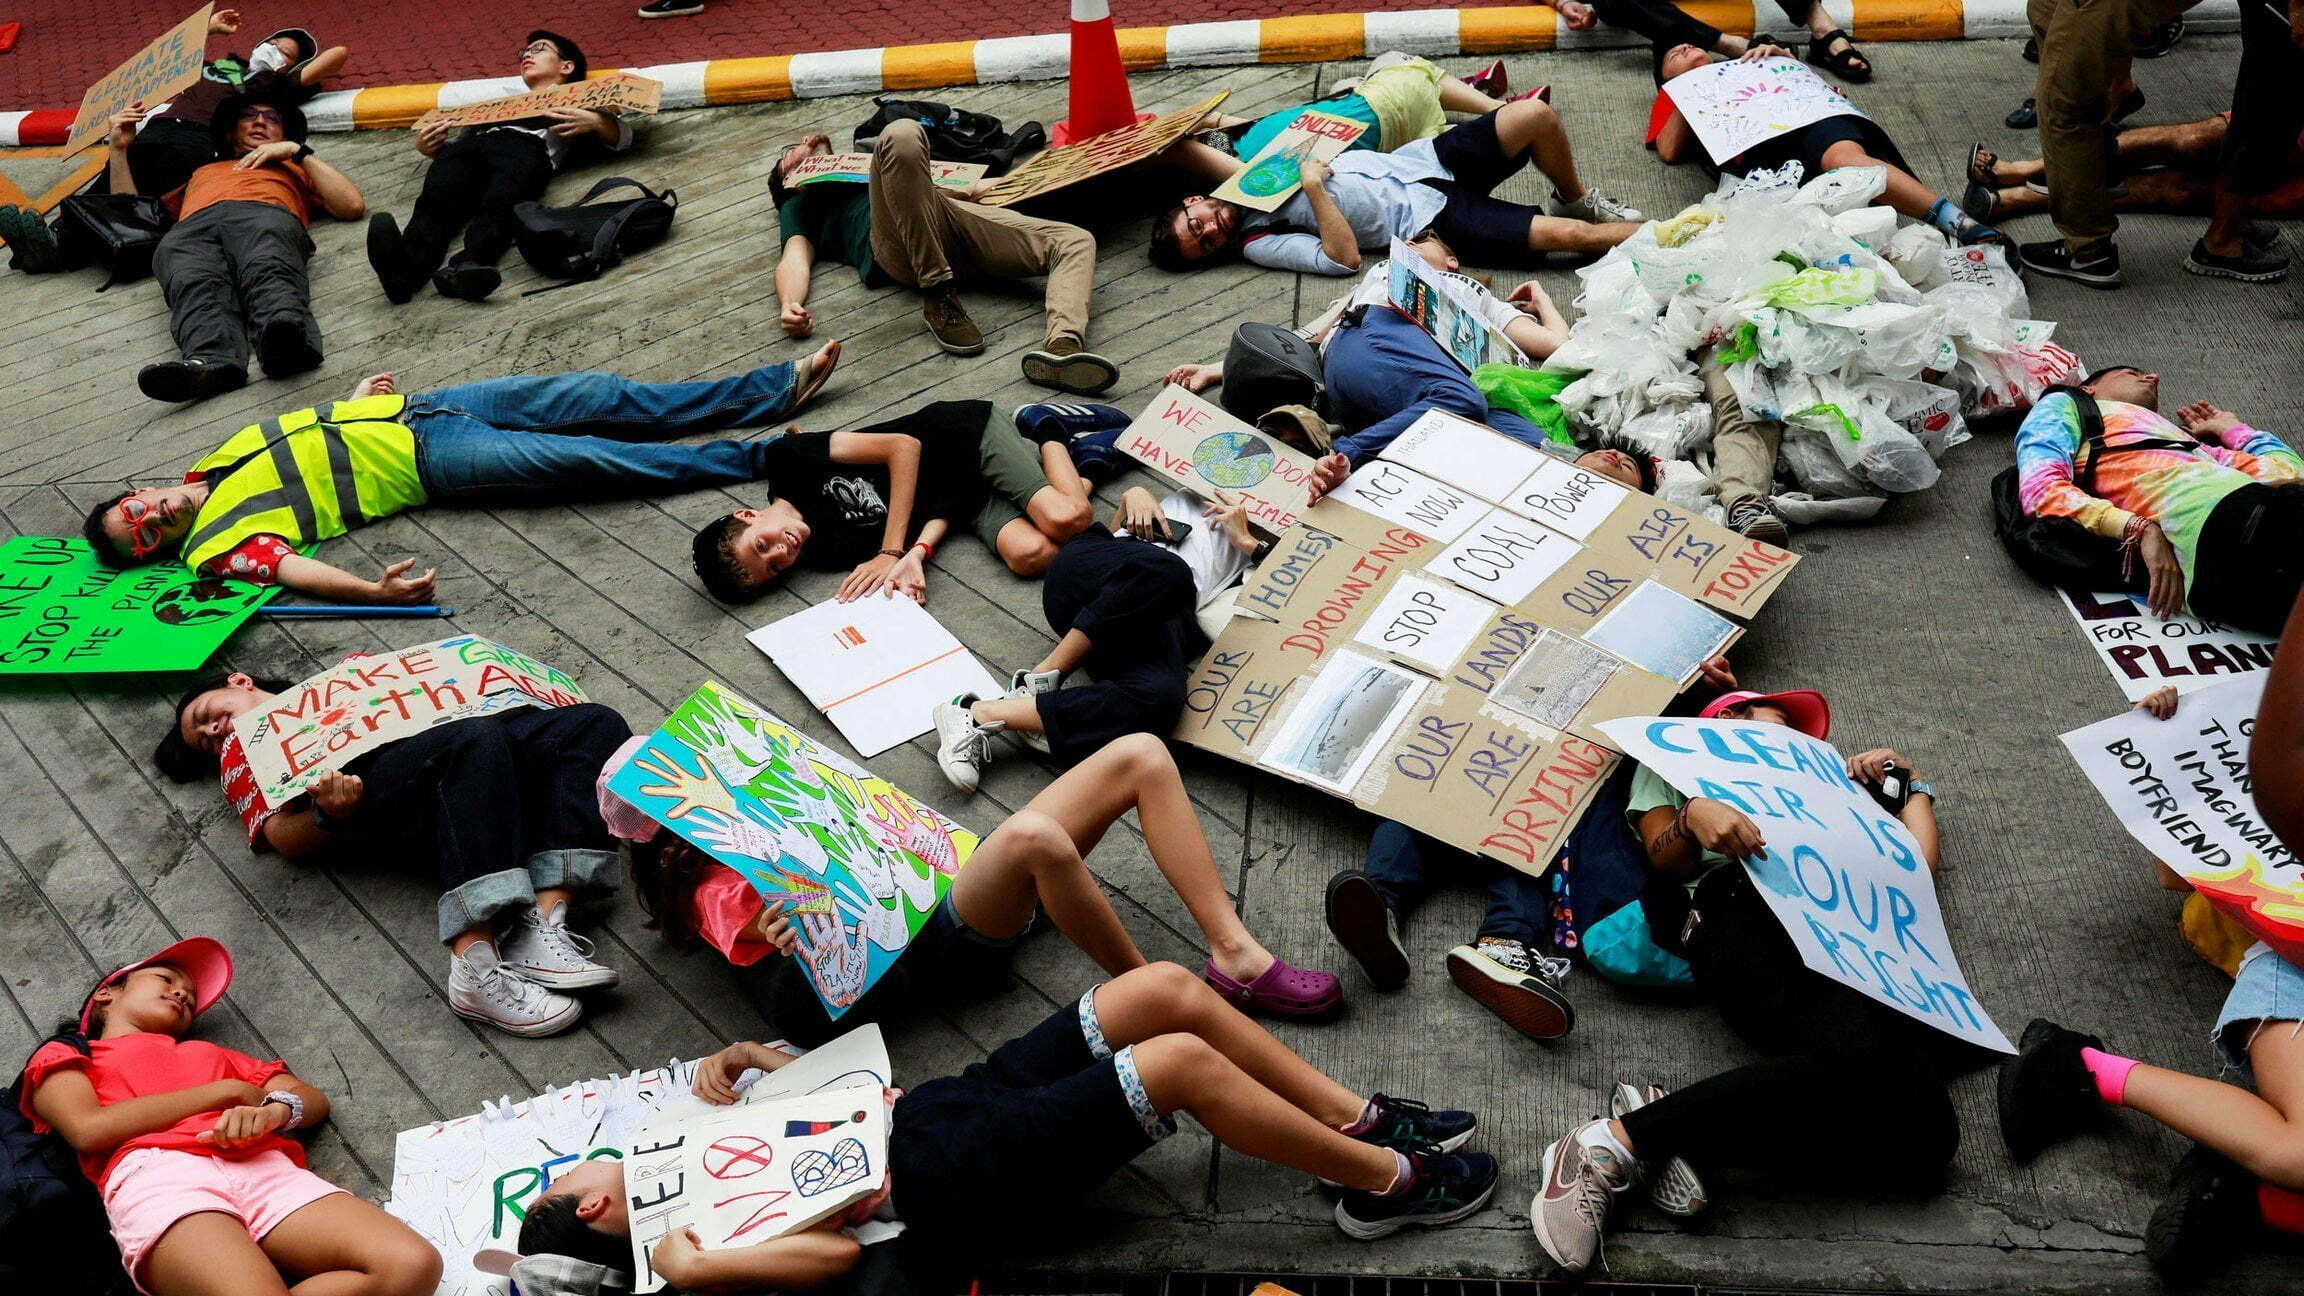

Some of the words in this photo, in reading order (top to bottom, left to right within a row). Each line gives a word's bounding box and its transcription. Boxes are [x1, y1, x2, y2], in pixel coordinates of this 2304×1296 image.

[90, 28, 186, 105] CLIMATE
[569, 76, 638, 94] LAST
[1161, 399, 1213, 433] WE
[1130, 436, 1194, 476] HAVE
[1355, 466, 1410, 508] ACT
[1238, 491, 1297, 528] TIME
[1405, 487, 1465, 527] NOW
[1524, 472, 1607, 521] POWER
[13, 538, 90, 566] UP
[1453, 525, 1548, 582] COAL
[1562, 569, 1633, 616] OUR
[1626, 508, 1688, 560] AIR
[1672, 534, 1715, 568] IS
[1703, 541, 1792, 600] TOXIC
[0, 605, 80, 663] STOP
[62, 627, 125, 662] THE
[111, 561, 186, 610] PLANE
[1185, 650, 1248, 713] OUR
[1249, 531, 1334, 610] HOMES
[1221, 680, 1281, 740] ARE
[1280, 528, 1430, 660] DROWNING
[1384, 591, 1446, 647] STOP
[2161, 621, 2233, 638] OUR
[267, 649, 443, 735] MAKE
[459, 640, 581, 696] GREA
[477, 664, 585, 707] AGAI
[1394, 715, 1467, 781] OUR
[1454, 613, 1540, 694] LANDS
[279, 681, 466, 779] Earth
[1463, 730, 1531, 798] ARE
[1645, 721, 1858, 795] CLEAN
[2199, 717, 2253, 795] THAN
[1479, 738, 1614, 863] DRYING
[1695, 776, 1829, 830] AIR
[1848, 806, 1917, 873] IS
[2105, 736, 2232, 868] BOYFRIEND
[2174, 749, 2302, 870] IMAGINARY
[1793, 844, 1945, 972] OUR
[1801, 910, 1983, 1033] RIGHT
